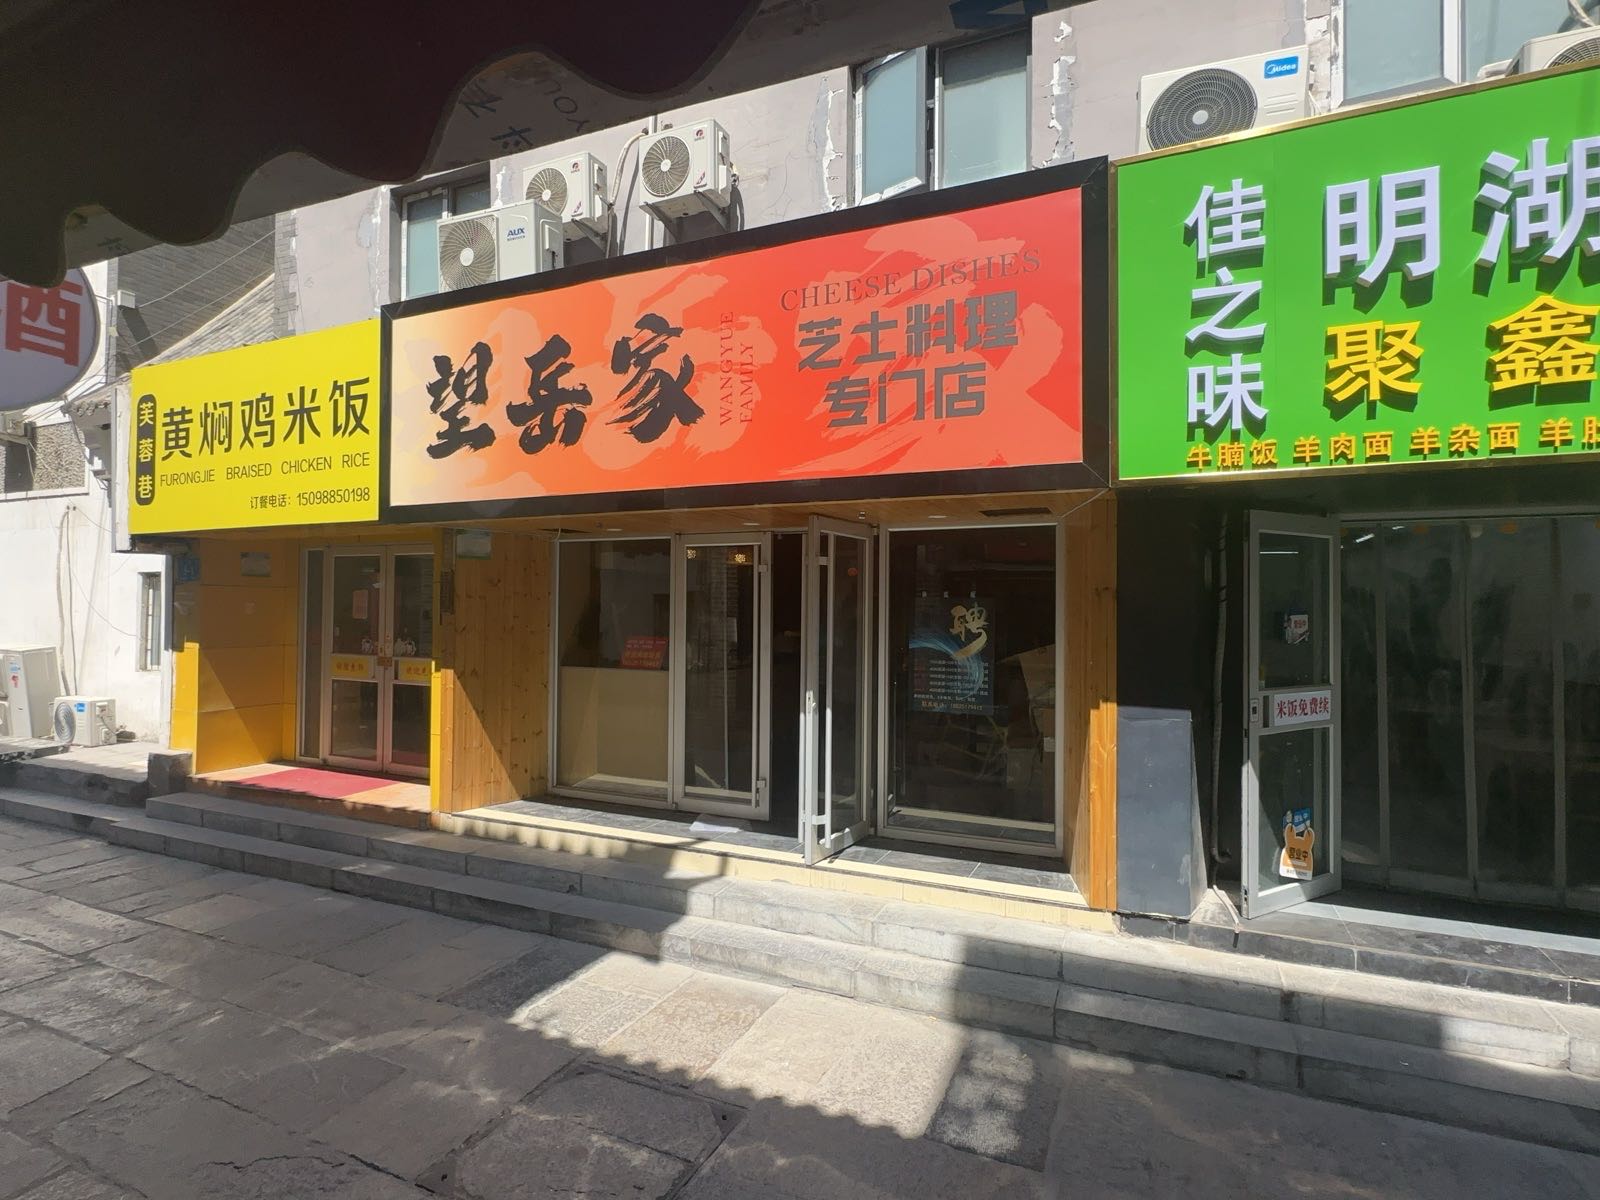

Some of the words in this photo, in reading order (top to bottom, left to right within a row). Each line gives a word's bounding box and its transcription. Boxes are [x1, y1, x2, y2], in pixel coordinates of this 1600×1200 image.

[1266, 63, 1296, 75] Midea
[507, 227, 525, 237] AUX
[1326, 136, 1600, 287] 明湖
[780, 272, 901, 312] CHEESE
[913, 248, 1041, 291] DISHES
[1184, 178, 1269, 430] 佳之味
[719, 311, 734, 426] WANGYUE
[798, 290, 1019, 372] 芝士料理
[1326, 295, 1600, 402] 聚鑫
[161, 376, 370, 462] 黄焖鸡米饭
[426, 313, 706, 459] 望岳家
[739, 342, 754, 424] FAMILY
[823, 361, 986, 428] 专门店
[138, 402, 154, 499] 芙蓉巷
[160, 469, 216, 487] FURONGJIE
[226, 462, 272, 480] BRAISED
[281, 456, 332, 475] CHICKEN
[342, 452, 370, 468] RICE
[1187, 439, 1278, 470] 牛腩饭
[1293, 431, 1394, 463] 羊肉面
[1410, 422, 1521, 454] 羊杂面
[1276, 697, 1329, 719] 米饭免费续
